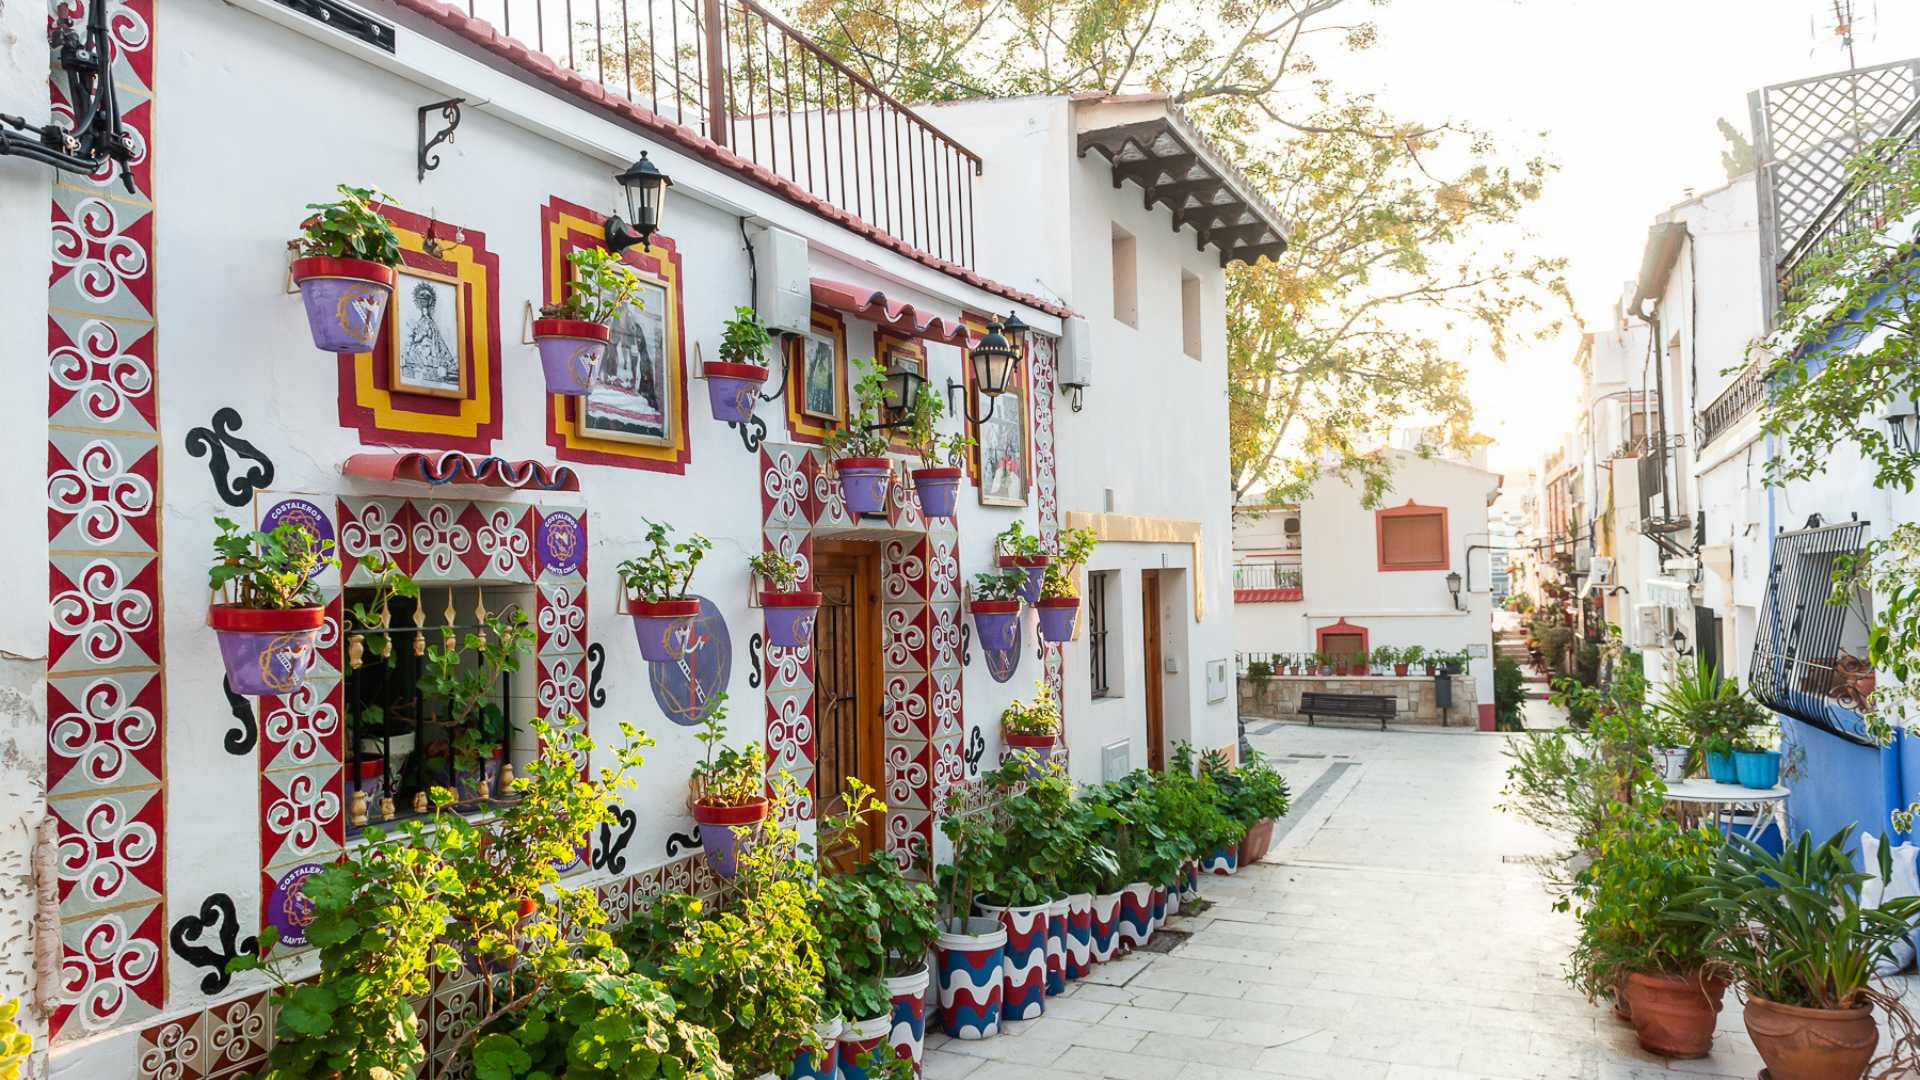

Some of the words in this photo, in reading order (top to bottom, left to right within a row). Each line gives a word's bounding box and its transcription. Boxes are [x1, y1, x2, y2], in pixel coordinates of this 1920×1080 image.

[271, 502, 322, 521] COSTALEROS
[544, 513, 577, 529] COSTALEROS
[563, 562, 577, 574] CRUZ
